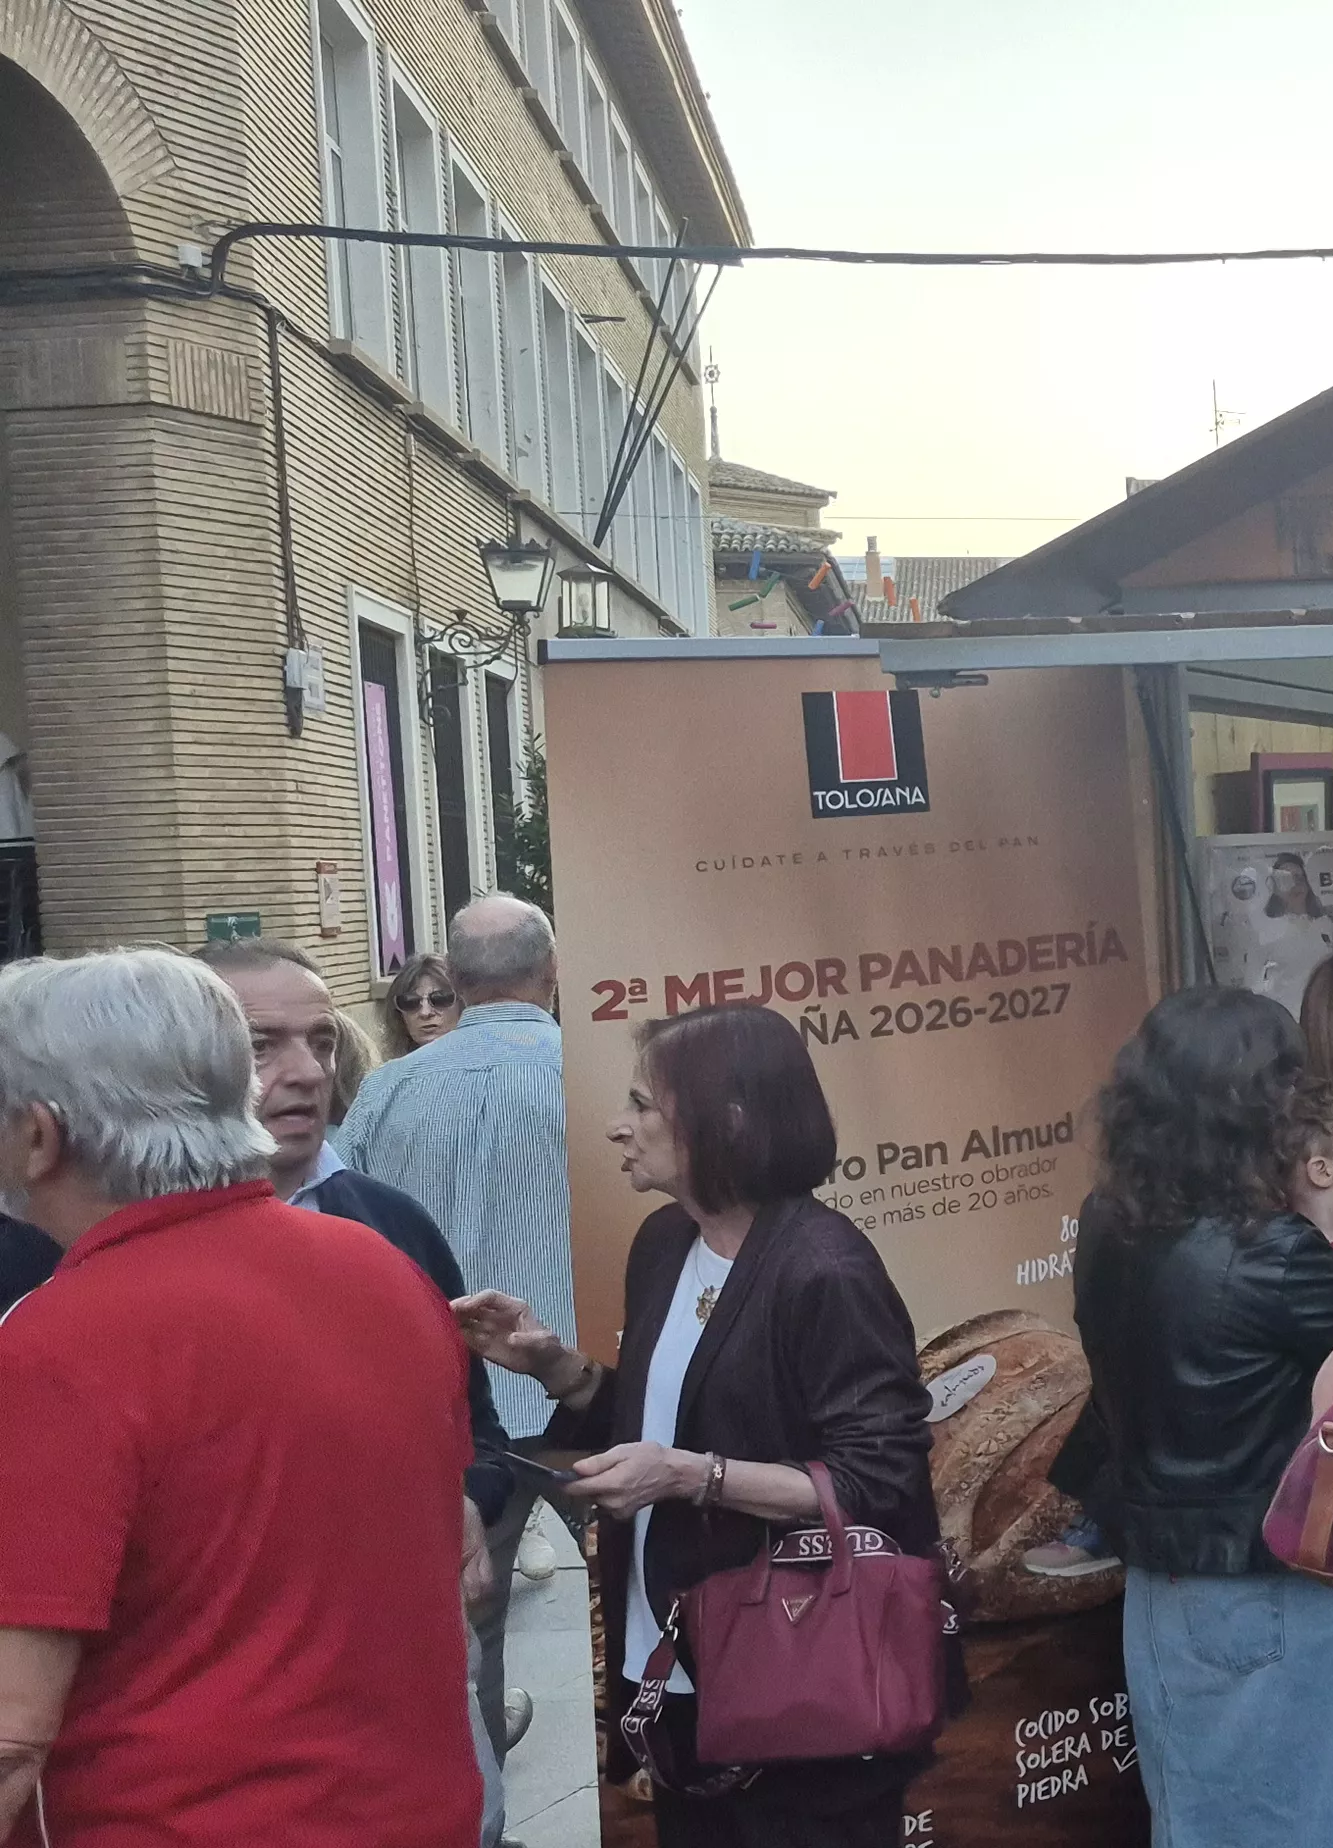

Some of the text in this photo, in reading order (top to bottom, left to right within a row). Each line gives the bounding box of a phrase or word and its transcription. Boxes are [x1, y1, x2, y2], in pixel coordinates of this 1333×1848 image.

[813, 785, 926, 811] TOLOSANA
[695, 835, 1040, 873] CUÍDATE A TRAVÉS DEL PAN
[591, 920, 1128, 1022] 2ª MEJOR PANADERÍA
[800, 983, 1071, 1047] ÑA 2026-2027
[826, 1112, 1074, 1184] ro Pan Almud
[819, 1156, 1058, 1209] do en nuestro obrador
[854, 1215, 877, 1231] ce
[884, 1202, 926, 1227] más
[932, 1197, 961, 1217] de
[969, 1190, 998, 1212] 20
[1015, 1692, 1129, 1748] COCIDO SOB
[1016, 1725, 1129, 1778] SOLERA DE
[1017, 1764, 1089, 1808] PIEDRA
